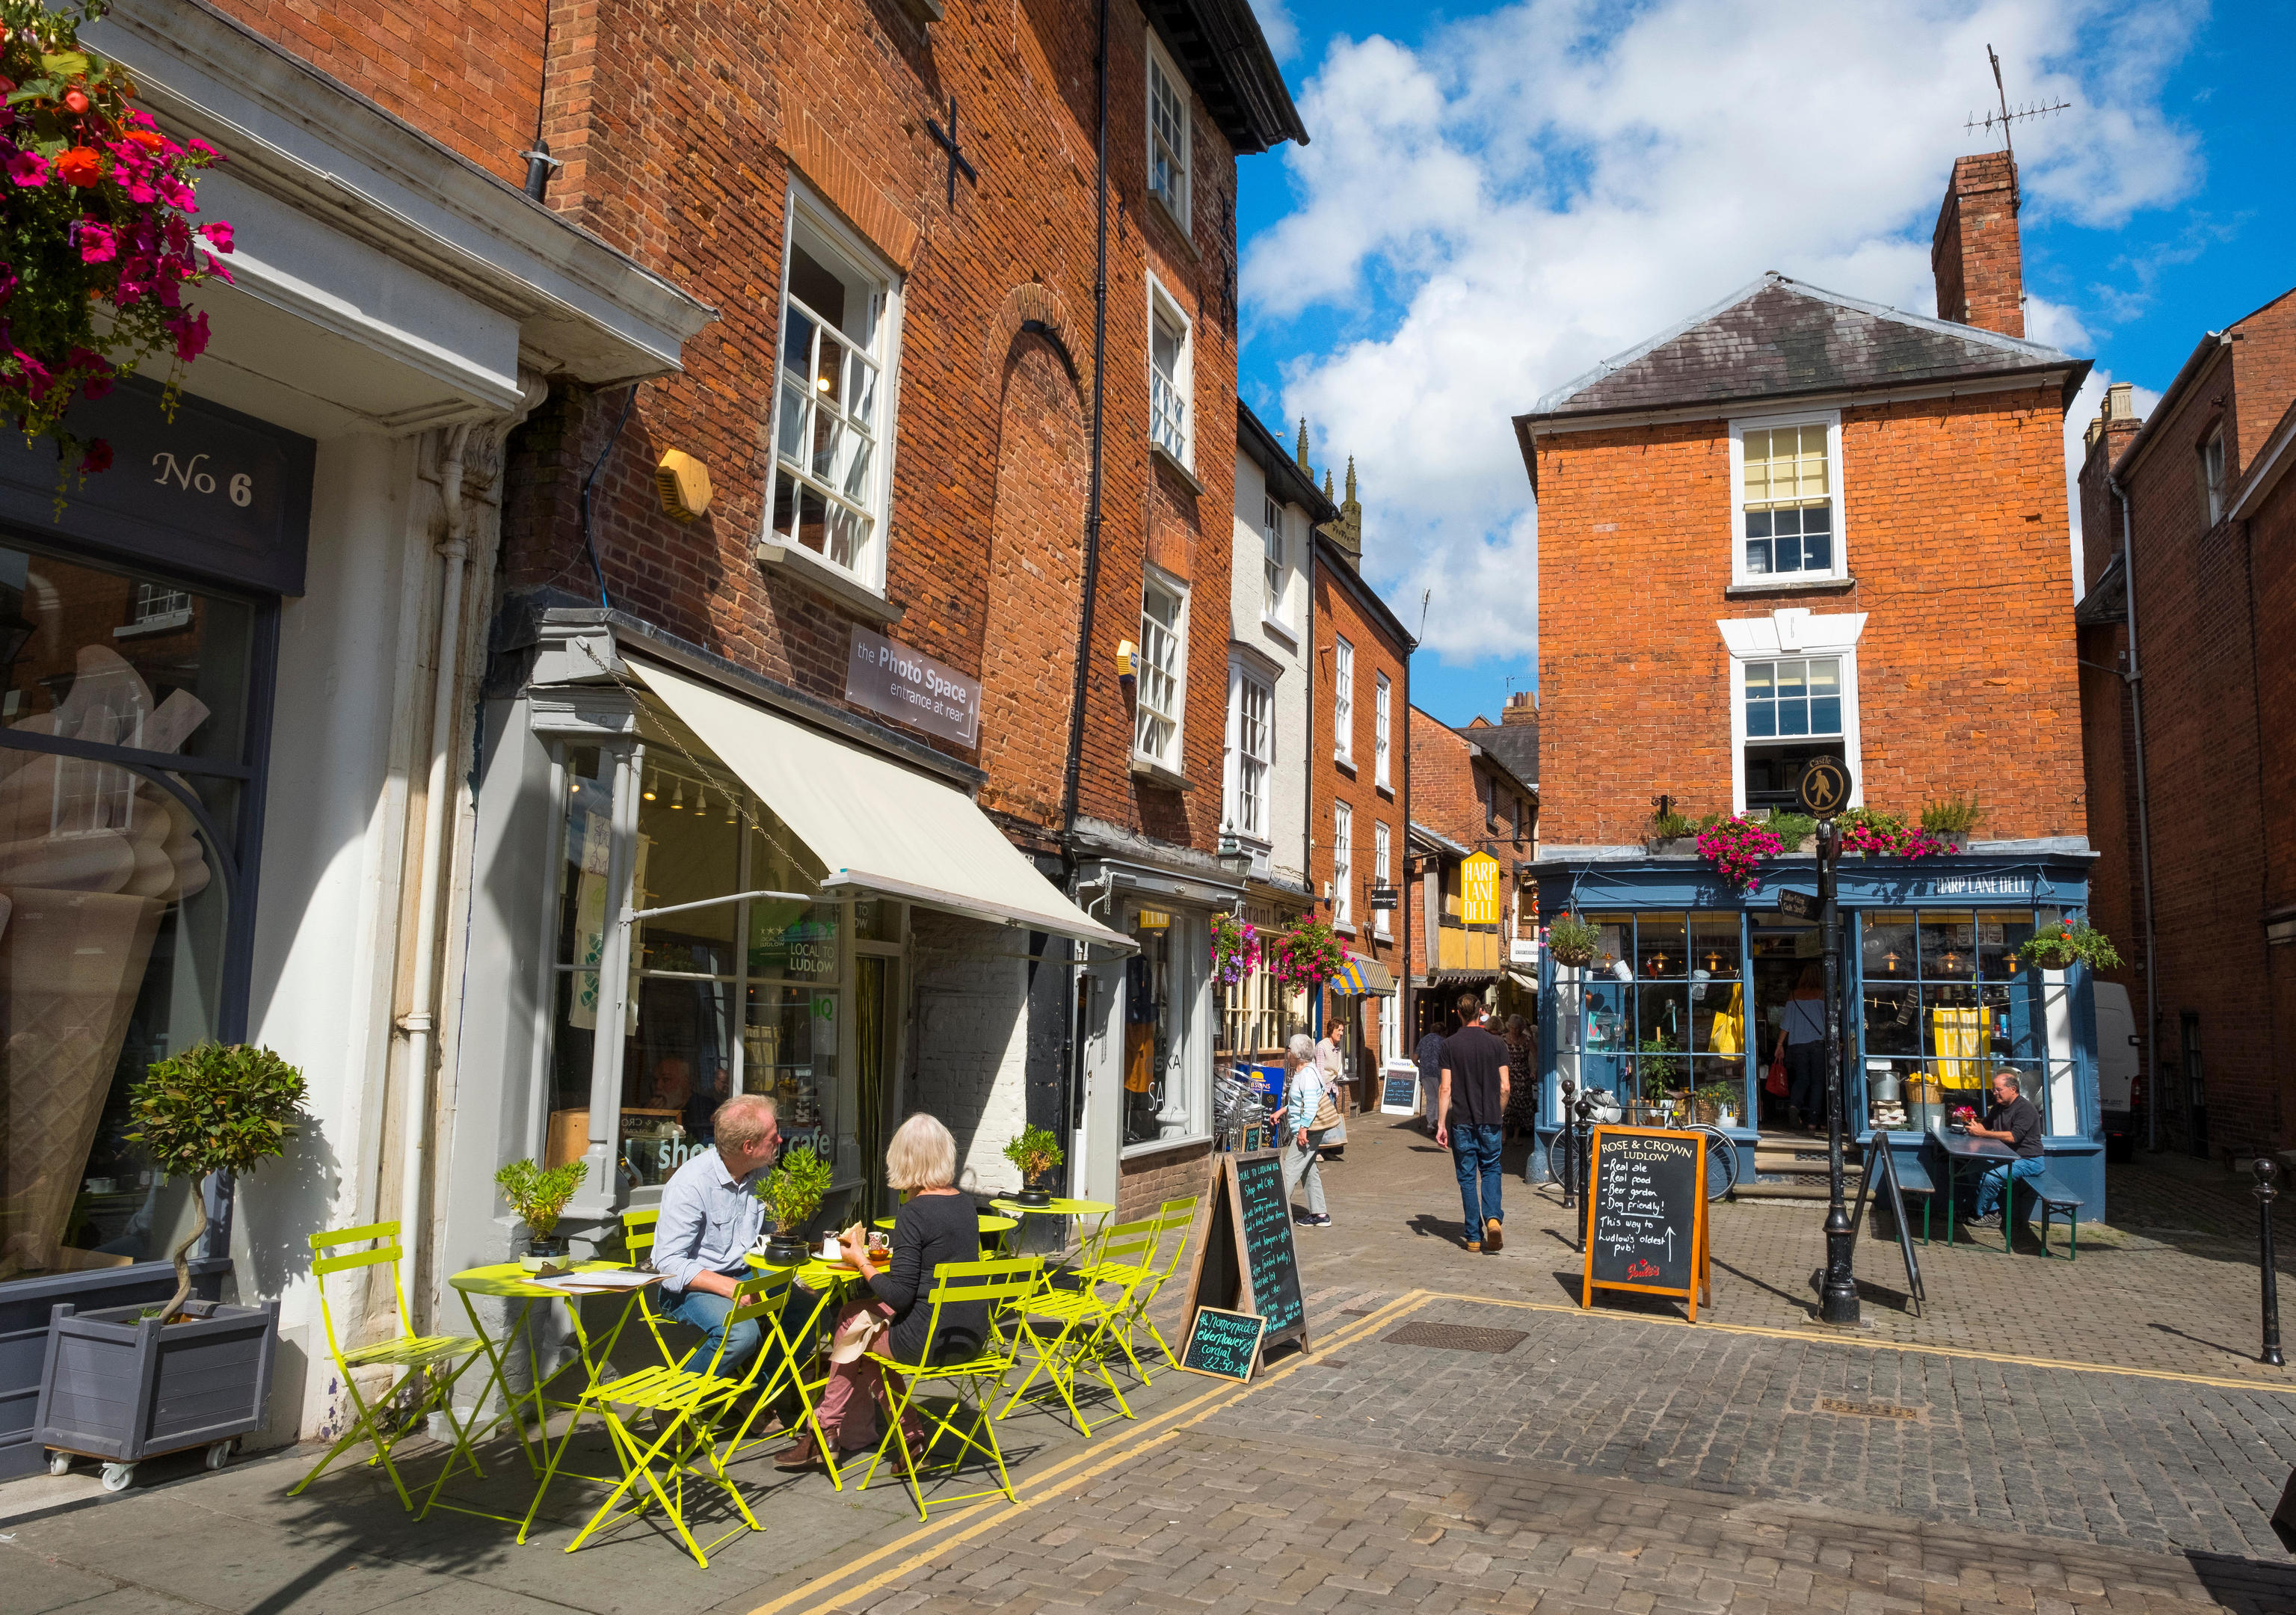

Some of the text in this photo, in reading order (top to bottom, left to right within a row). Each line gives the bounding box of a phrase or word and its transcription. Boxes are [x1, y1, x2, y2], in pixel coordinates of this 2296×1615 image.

[153, 452, 252, 507] No 6
[858, 642, 967, 704] the Photo Space
[890, 683, 964, 723] entrance at rear
[1809, 755, 1831, 768] Castle
[1813, 810, 1835, 819] Square
[1464, 862, 1496, 881] HARP
[1465, 882, 1495, 900] LANE
[1937, 876, 2029, 893] HARP LANE DELI.
[1464, 901, 1495, 920] DELI.
[791, 943, 834, 958] LOCAL TO
[790, 958, 834, 973] LUDLOW
[810, 998, 833, 1021] HQ
[1145, 1054, 1181, 1073] OSKA
[1601, 1140, 1693, 1158] ROSE & CROWN
[1624, 1151, 1669, 1162] LUDLOW
[1238, 1163, 1279, 1181] LOCAL TO LUDLOW HQ
[1632, 1163, 1647, 1172] ale
[1632, 1177, 1651, 1186] food
[1244, 1184, 1255, 1198] Shop
[1628, 1188, 1658, 1200] garden
[1628, 1200, 1664, 1216] friendly!
[1601, 1216, 1653, 1234] This way to
[1598, 1229, 1666, 1245] Ludlow's oldest
[1614, 1244, 1634, 1257] pub!
[1208, 1313, 1258, 1335] homemade
[1197, 1329, 1247, 1347] elderflower
[1201, 1344, 1231, 1361] cordial
